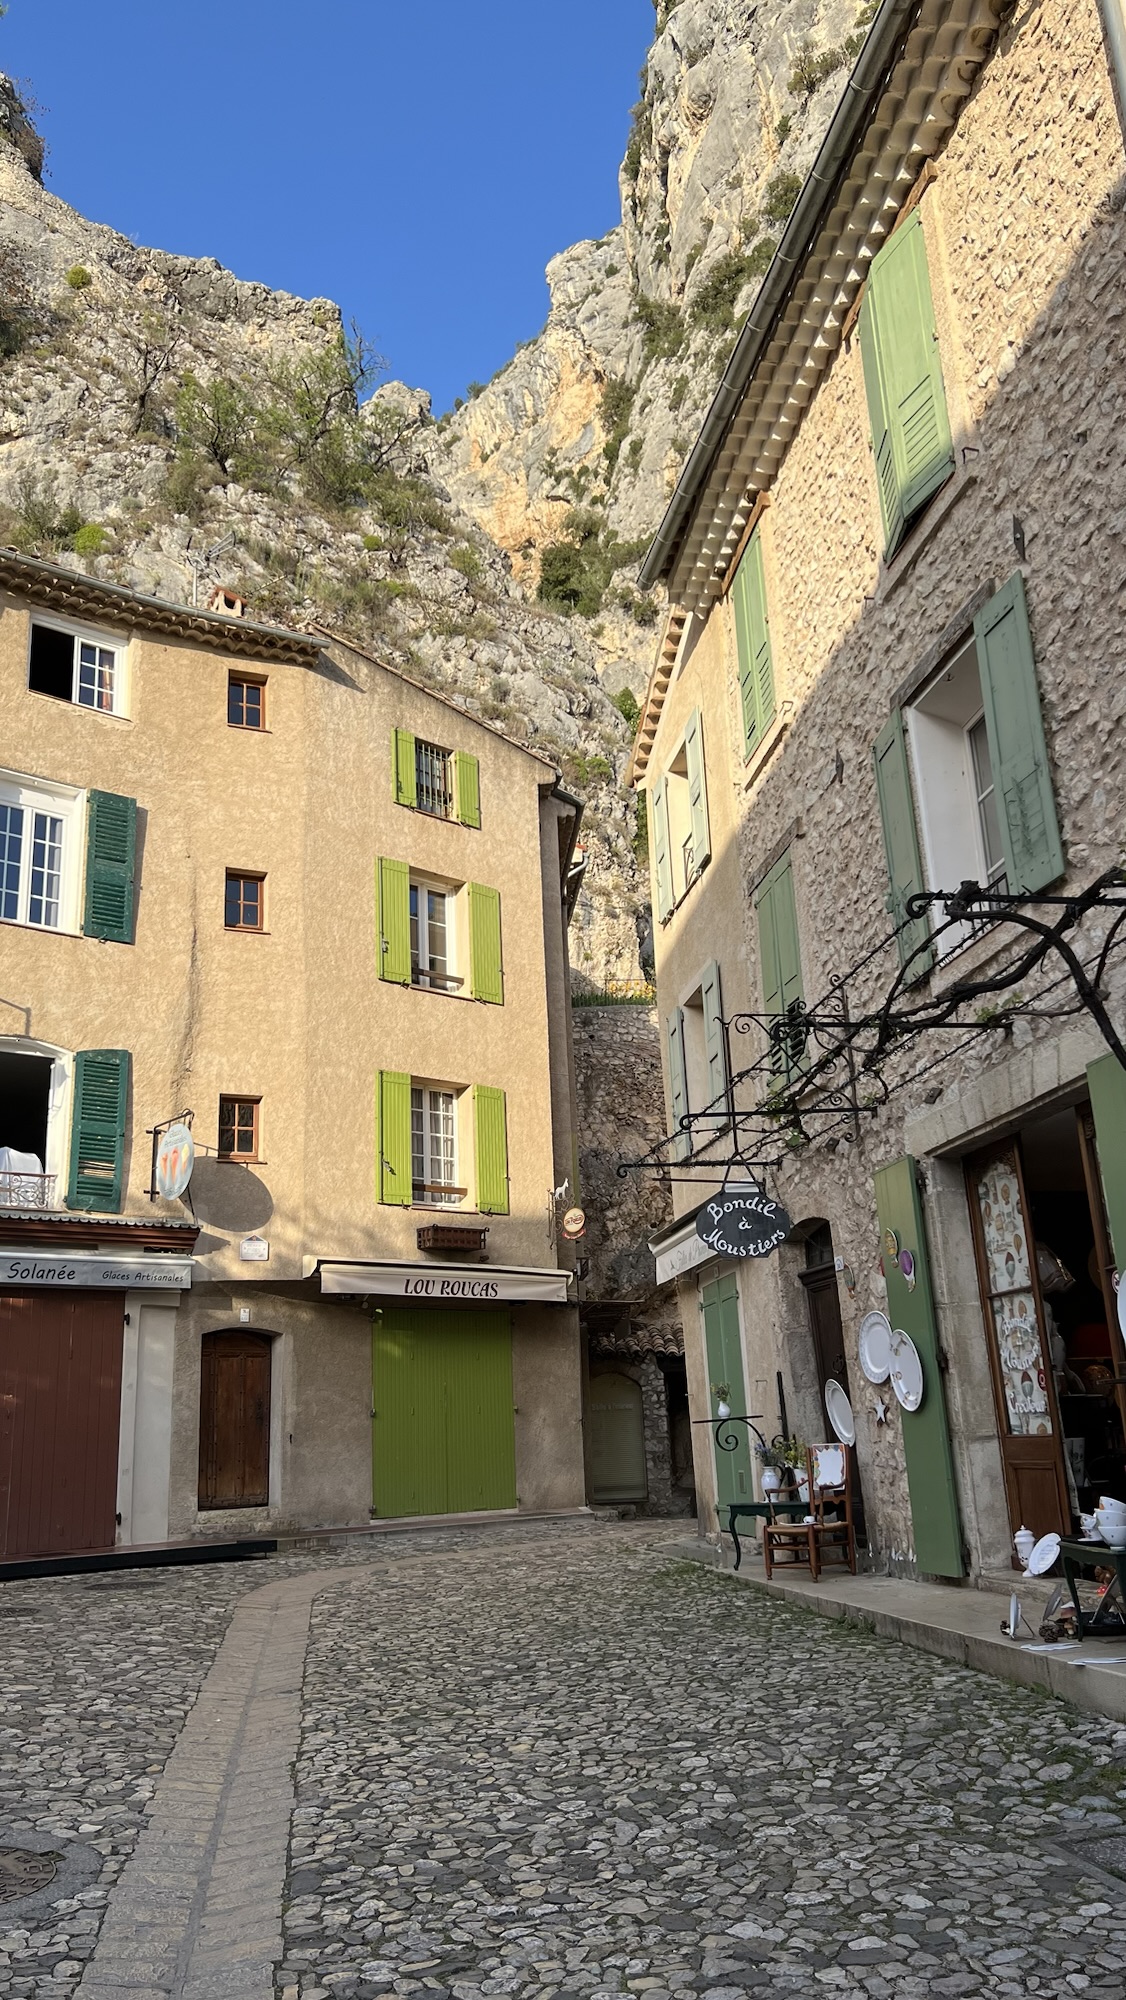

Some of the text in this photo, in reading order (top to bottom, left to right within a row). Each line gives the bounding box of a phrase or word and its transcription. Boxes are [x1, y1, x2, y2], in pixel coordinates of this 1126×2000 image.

[706, 1196, 777, 1225] Bondil
[738, 1216, 752, 1230] à
[702, 1228, 786, 1257] Moustiers
[7, 1261, 76, 1280] Solanée
[102, 1270, 184, 1283] Glaces Artisanales
[404, 1278, 499, 1298] LOU ROUCAS
